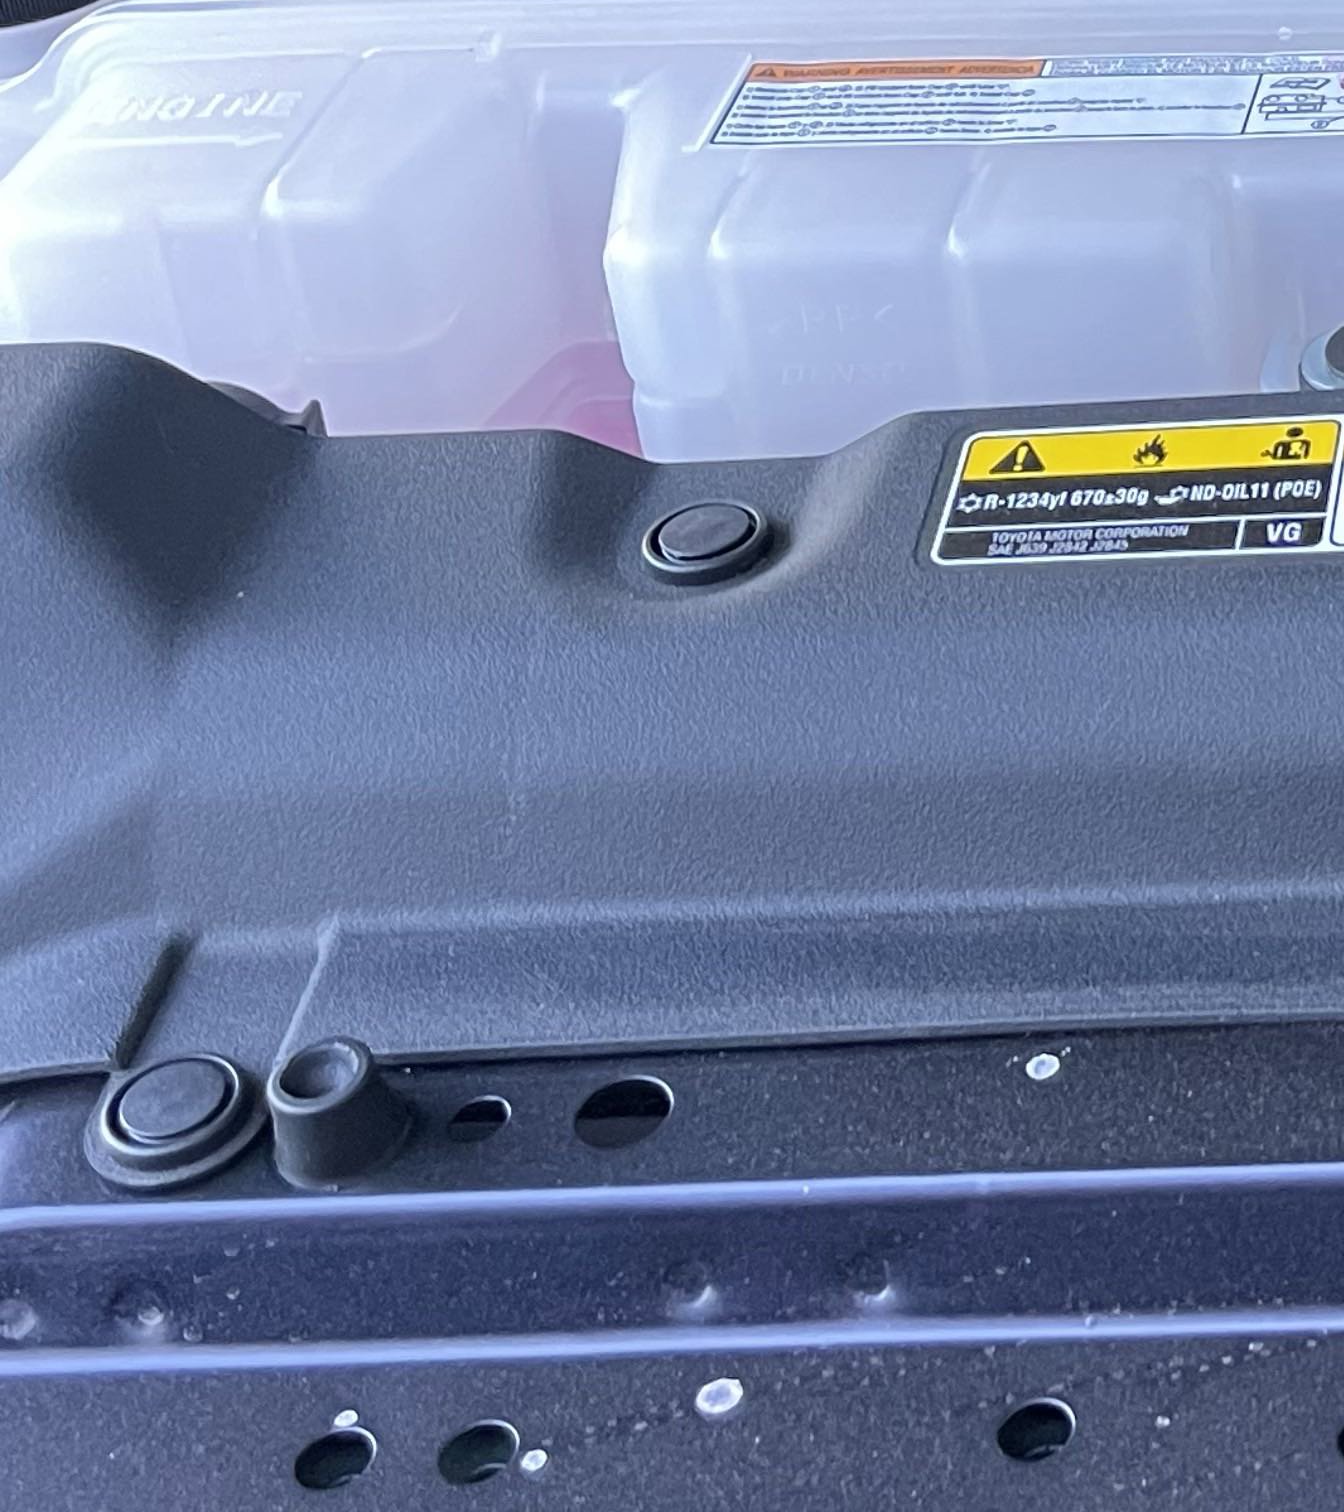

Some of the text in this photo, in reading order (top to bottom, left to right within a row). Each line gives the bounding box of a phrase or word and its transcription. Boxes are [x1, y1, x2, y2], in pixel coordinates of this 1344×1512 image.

[1070, 488, 1149, 506] 670±30g
[1190, 482, 1270, 501] ND-OIL11
[1273, 480, 1322, 500] (POE)
[991, 524, 1190, 543] TOYOTA MOTOR CORPORATION
[1266, 522, 1302, 543] VG
[987, 544, 1014, 556] SAE
